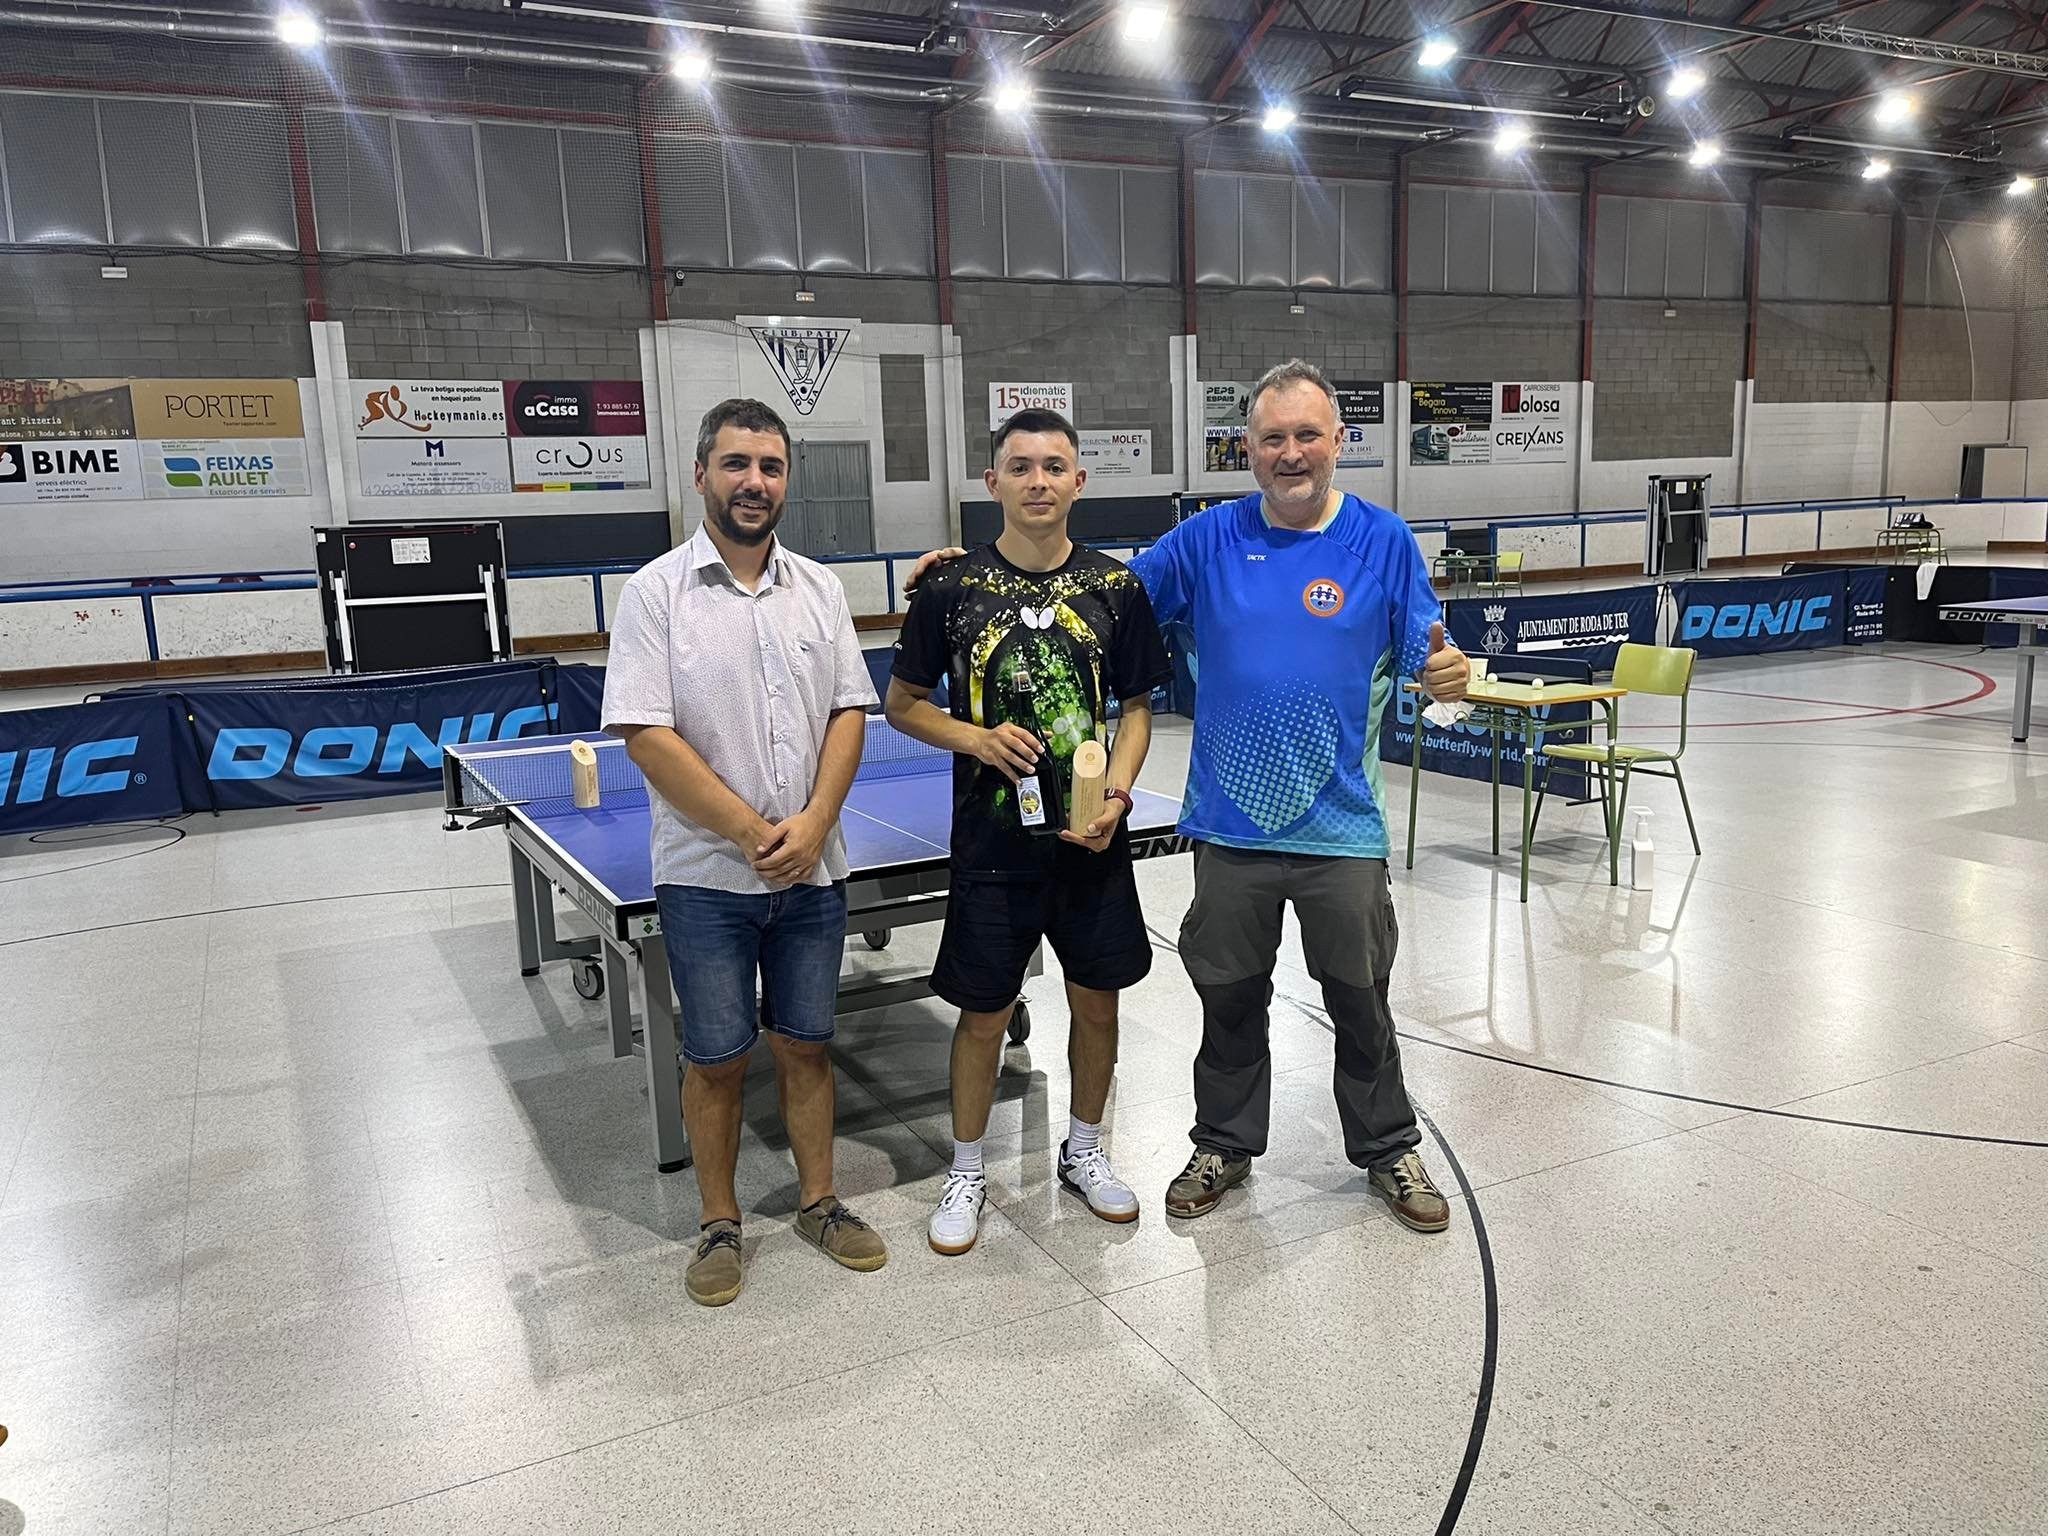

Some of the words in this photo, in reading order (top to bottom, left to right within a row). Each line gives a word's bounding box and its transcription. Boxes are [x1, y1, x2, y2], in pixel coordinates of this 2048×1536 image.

[762, 329, 798, 338] CLUB
[410, 385, 419, 393] La
[435, 385, 455, 394] botiga
[456, 385, 500, 394] especialitzada
[1206, 386, 1235, 395] PEPS
[554, 396, 578, 404] immo
[996, 387, 1020, 409] 15
[1021, 397, 1067, 409] years
[165, 394, 274, 418] PORTET
[524, 402, 579, 416] aCasa
[414, 410, 504, 423] Hockeymania.es
[1112, 435, 1142, 444] MOLET
[1496, 425, 1564, 452] CREIXANS
[32, 449, 119, 474] BIME
[206, 456, 274, 471] FEIXAS
[208, 472, 269, 486] AULET
[1682, 595, 1832, 640] DONIC
[1945, 611, 2007, 622] DONIC
[1518, 617, 1567, 641] AJUNTAMENT
[1569, 616, 1580, 633] DE
[1581, 615, 1602, 633] RODA
[1603, 613, 1613, 631] DE
[1614, 612, 1630, 629] TER
[577, 884, 613, 933] DONIC
